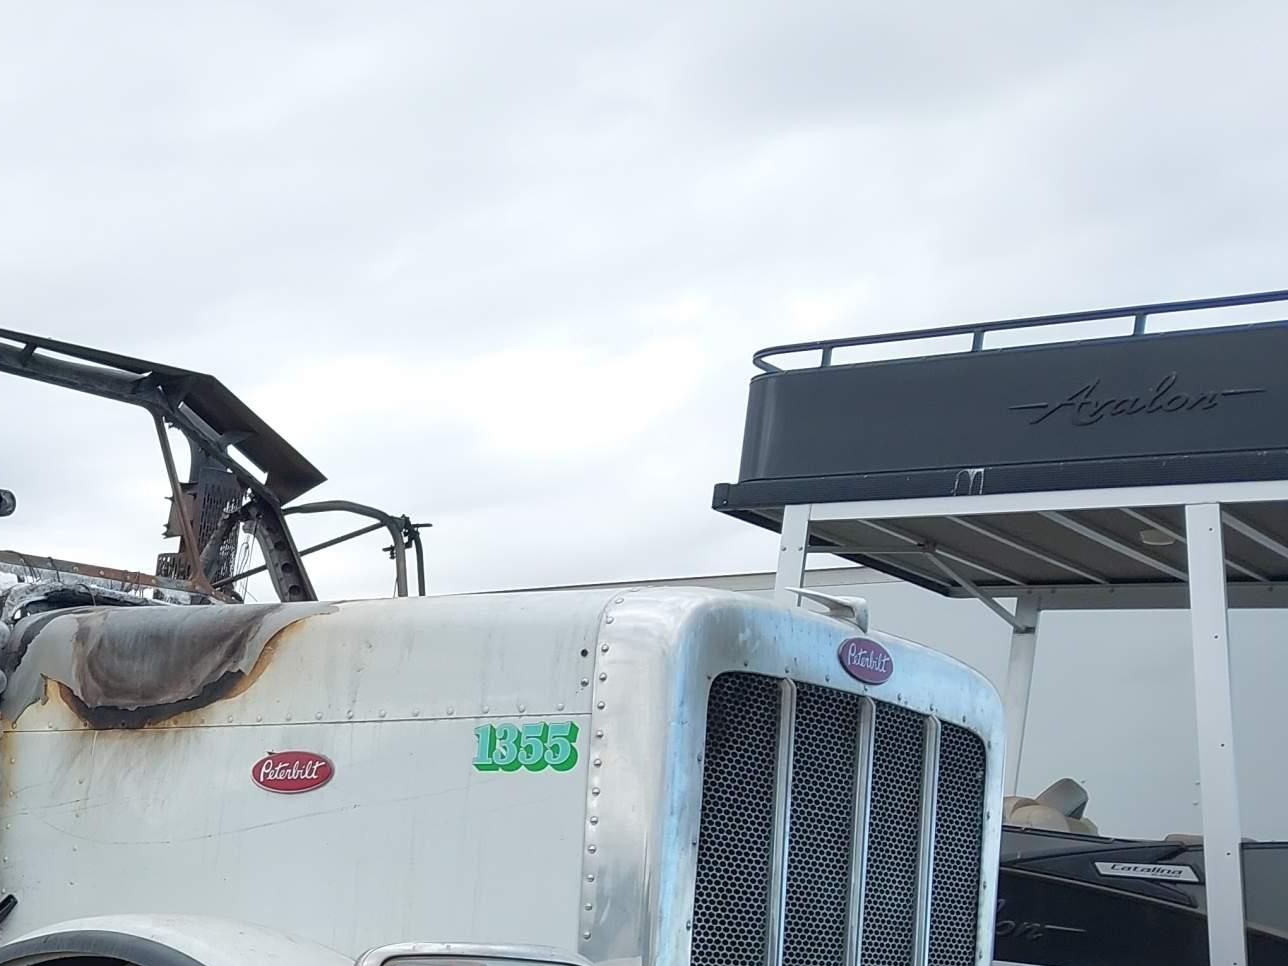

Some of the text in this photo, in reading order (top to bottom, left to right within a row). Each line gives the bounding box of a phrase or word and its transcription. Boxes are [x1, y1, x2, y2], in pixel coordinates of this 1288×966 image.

[1029, 371, 1218, 426] Avalon
[847, 642, 891, 673] Peterbilt
[473, 720, 579, 773] 1355
[259, 759, 326, 782] Peterbilt
[1110, 863, 1183, 876] Catalina
